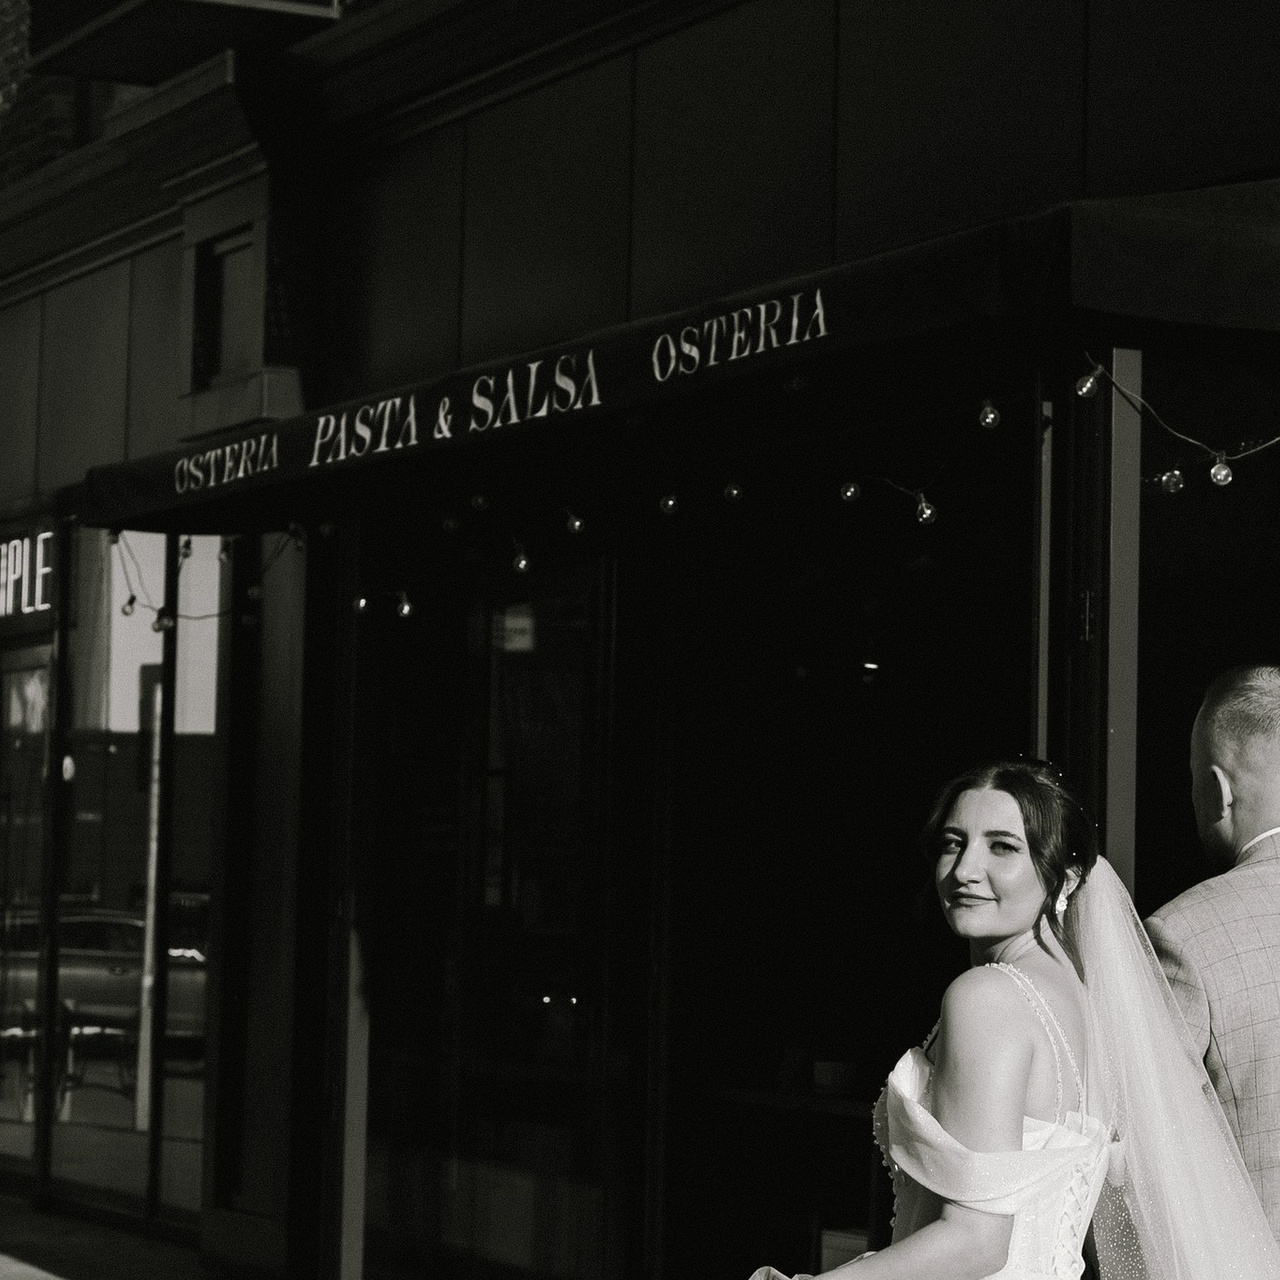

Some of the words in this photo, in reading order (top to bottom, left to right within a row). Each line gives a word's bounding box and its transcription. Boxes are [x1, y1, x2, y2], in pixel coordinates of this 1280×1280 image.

[175, 433, 278, 493] OSTERIA
[309, 393, 418, 467] PASTA
[433, 397, 451, 439] &
[469, 349, 601, 431] SALSA
[652, 288, 828, 382] OSTERIA
